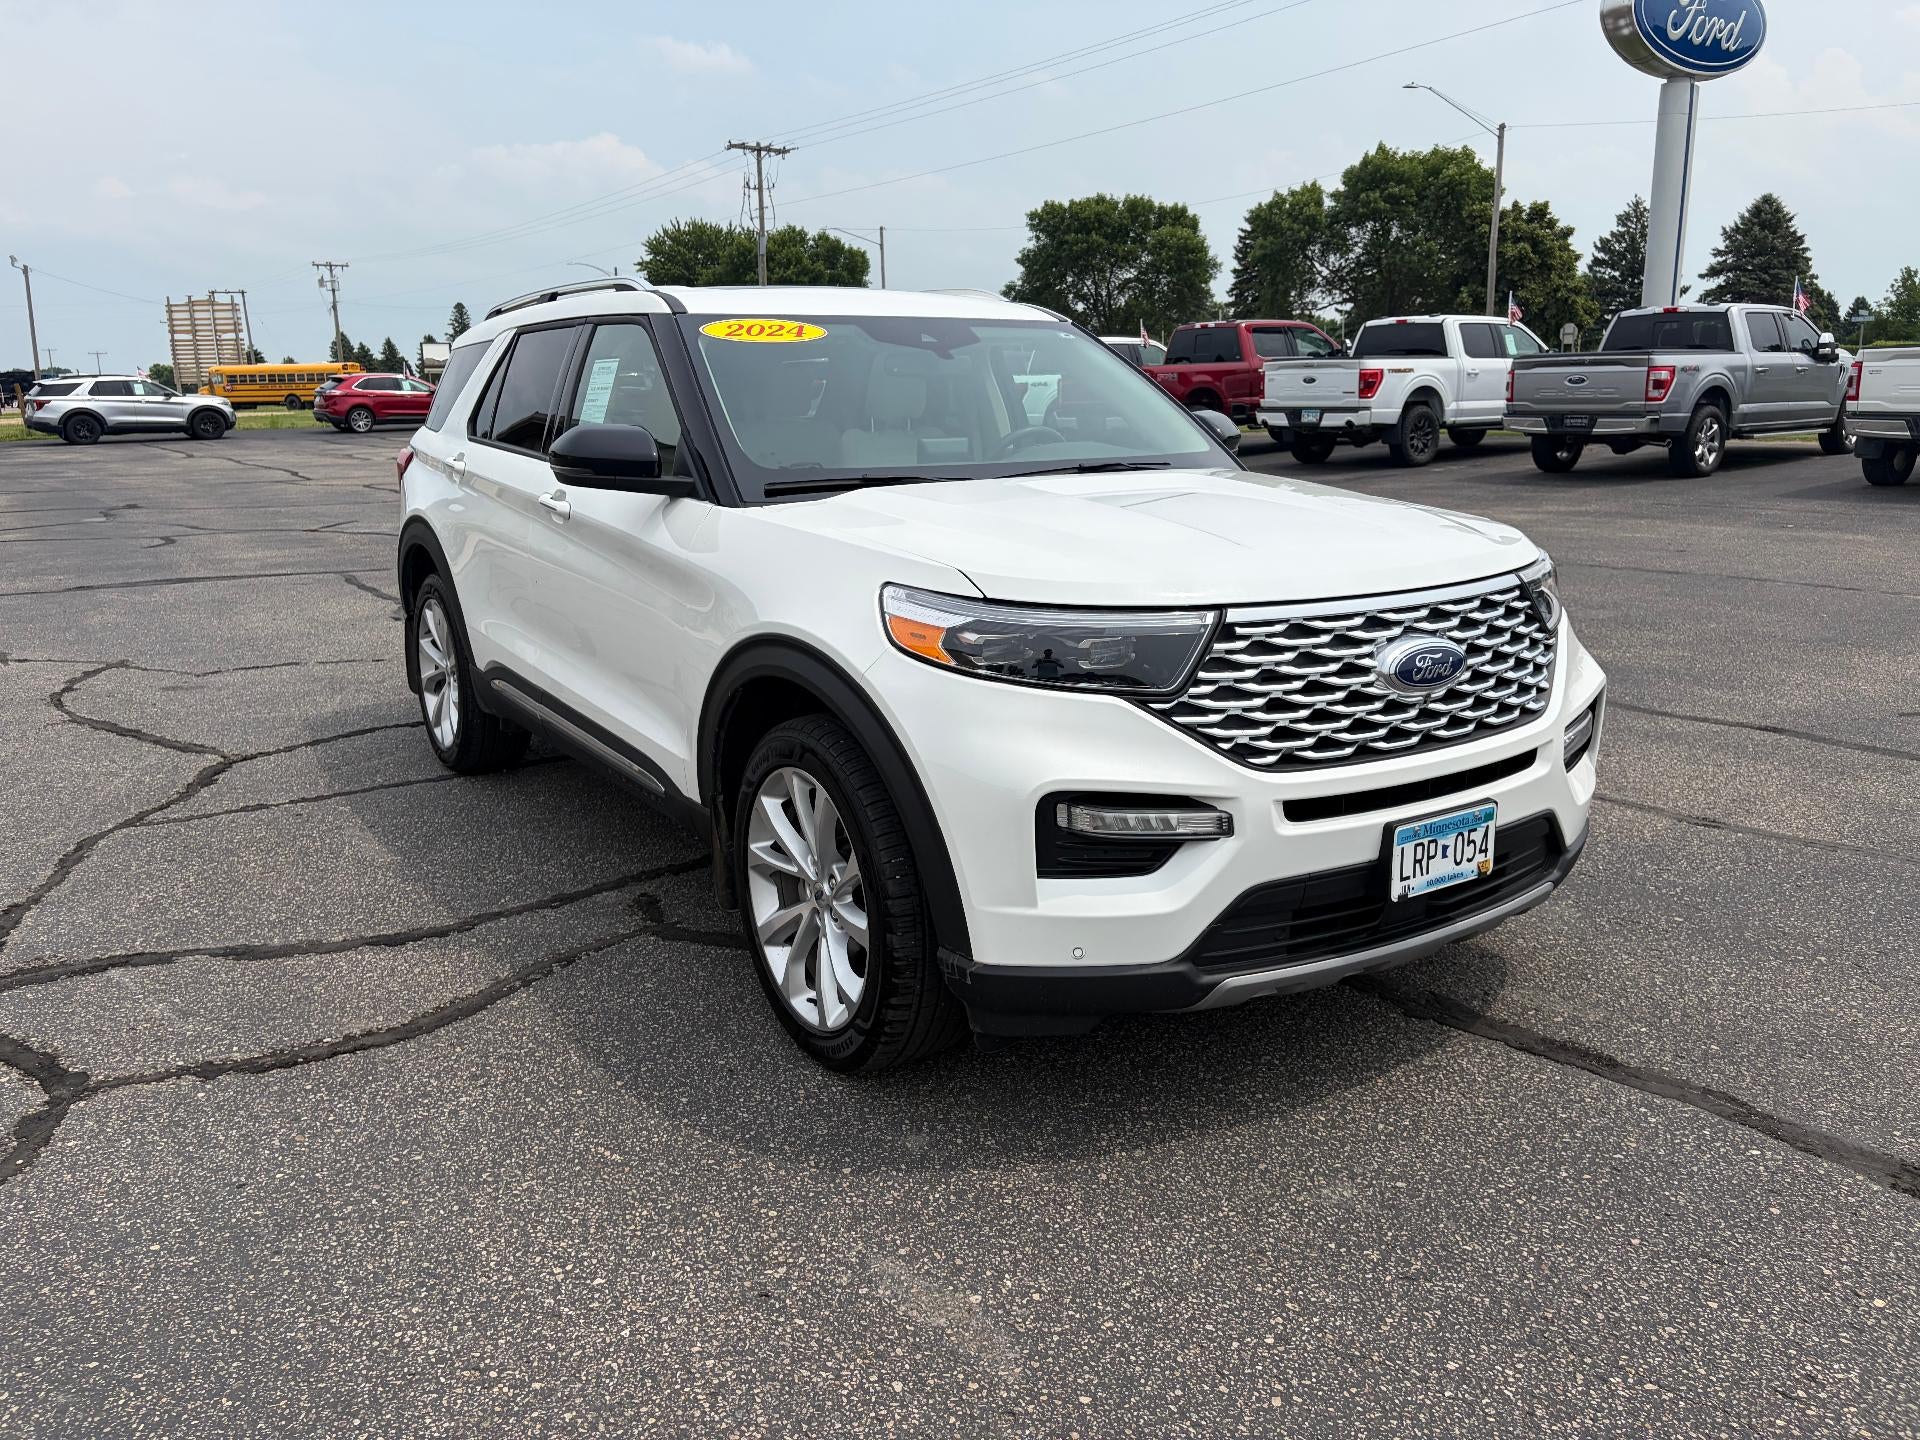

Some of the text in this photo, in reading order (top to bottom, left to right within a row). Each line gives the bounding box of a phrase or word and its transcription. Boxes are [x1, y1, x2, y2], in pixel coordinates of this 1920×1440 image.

[1666, 0, 1747, 52] Ford
[725, 323, 807, 338] 2024
[1412, 652, 1454, 681] Ford
[1400, 824, 1490, 883] LRP 054
